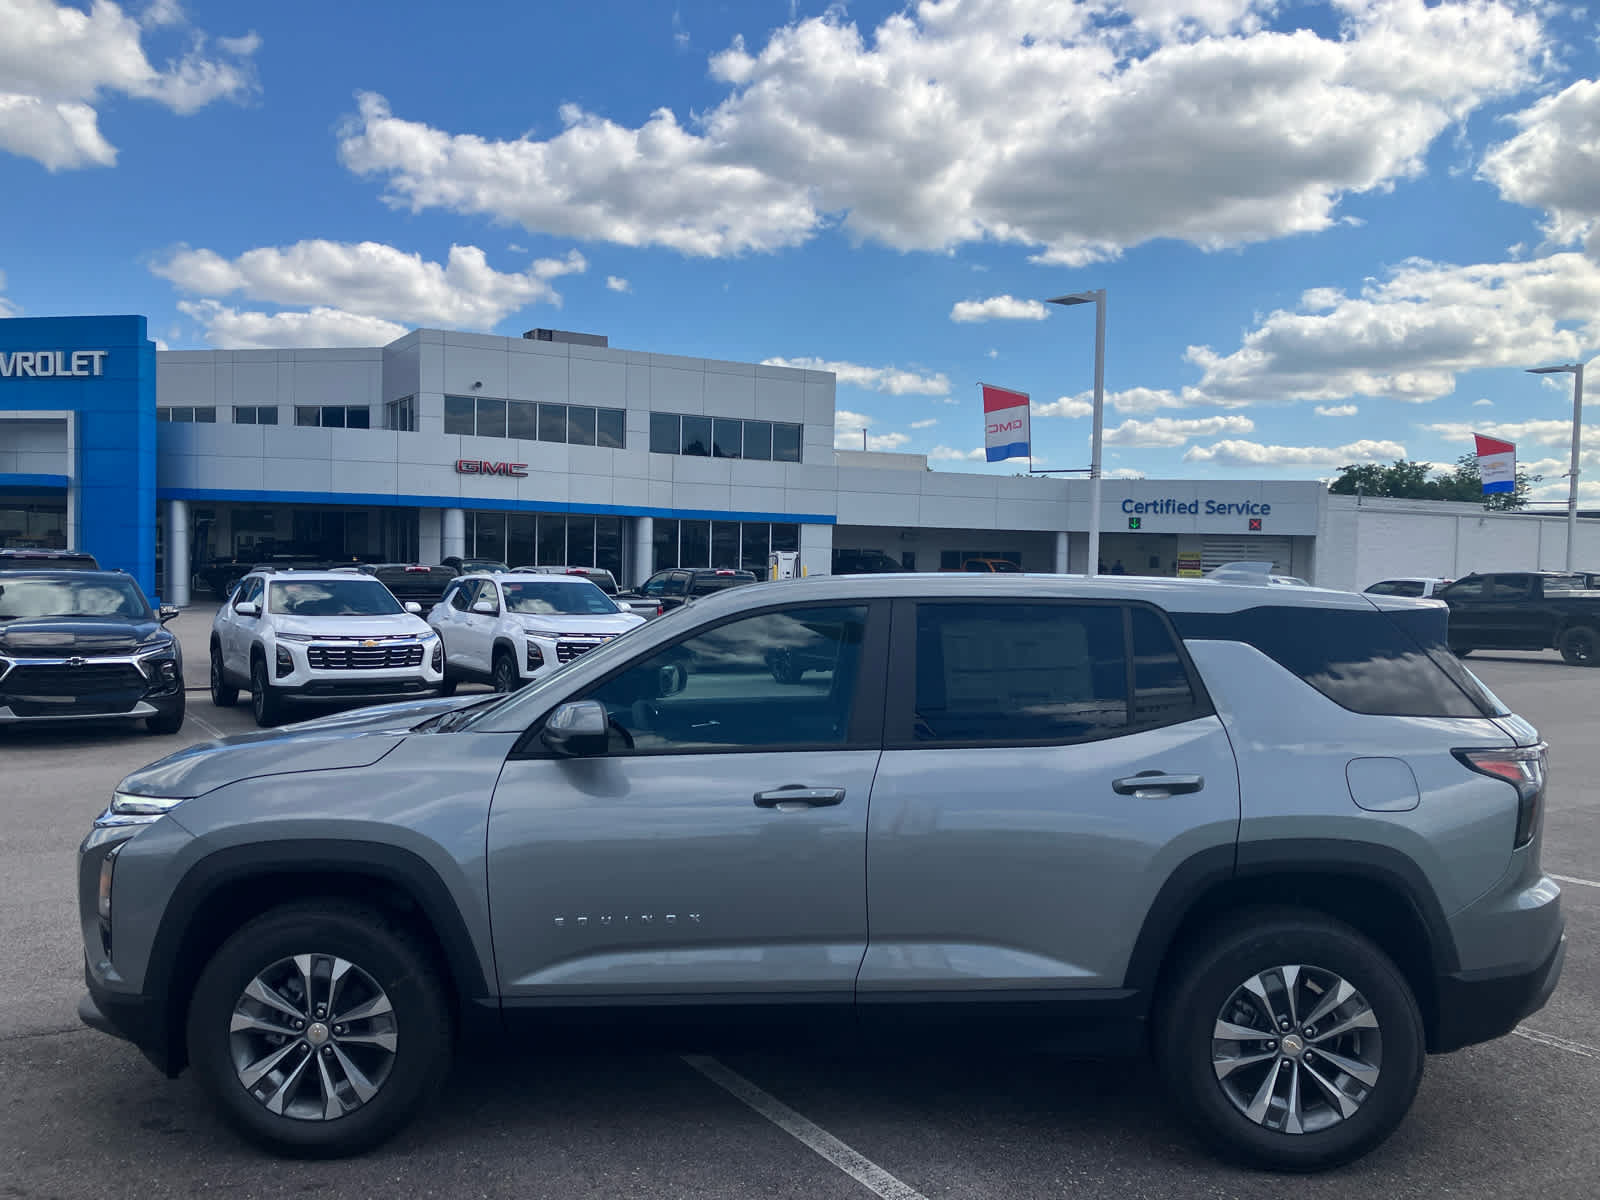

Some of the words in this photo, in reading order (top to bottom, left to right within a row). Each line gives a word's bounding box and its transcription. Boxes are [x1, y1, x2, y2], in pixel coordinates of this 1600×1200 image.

[0, 351, 108, 377] VROLET
[456, 459, 529, 477] GMC
[1121, 498, 1199, 515] Certified
[1204, 499, 1271, 516] Service
